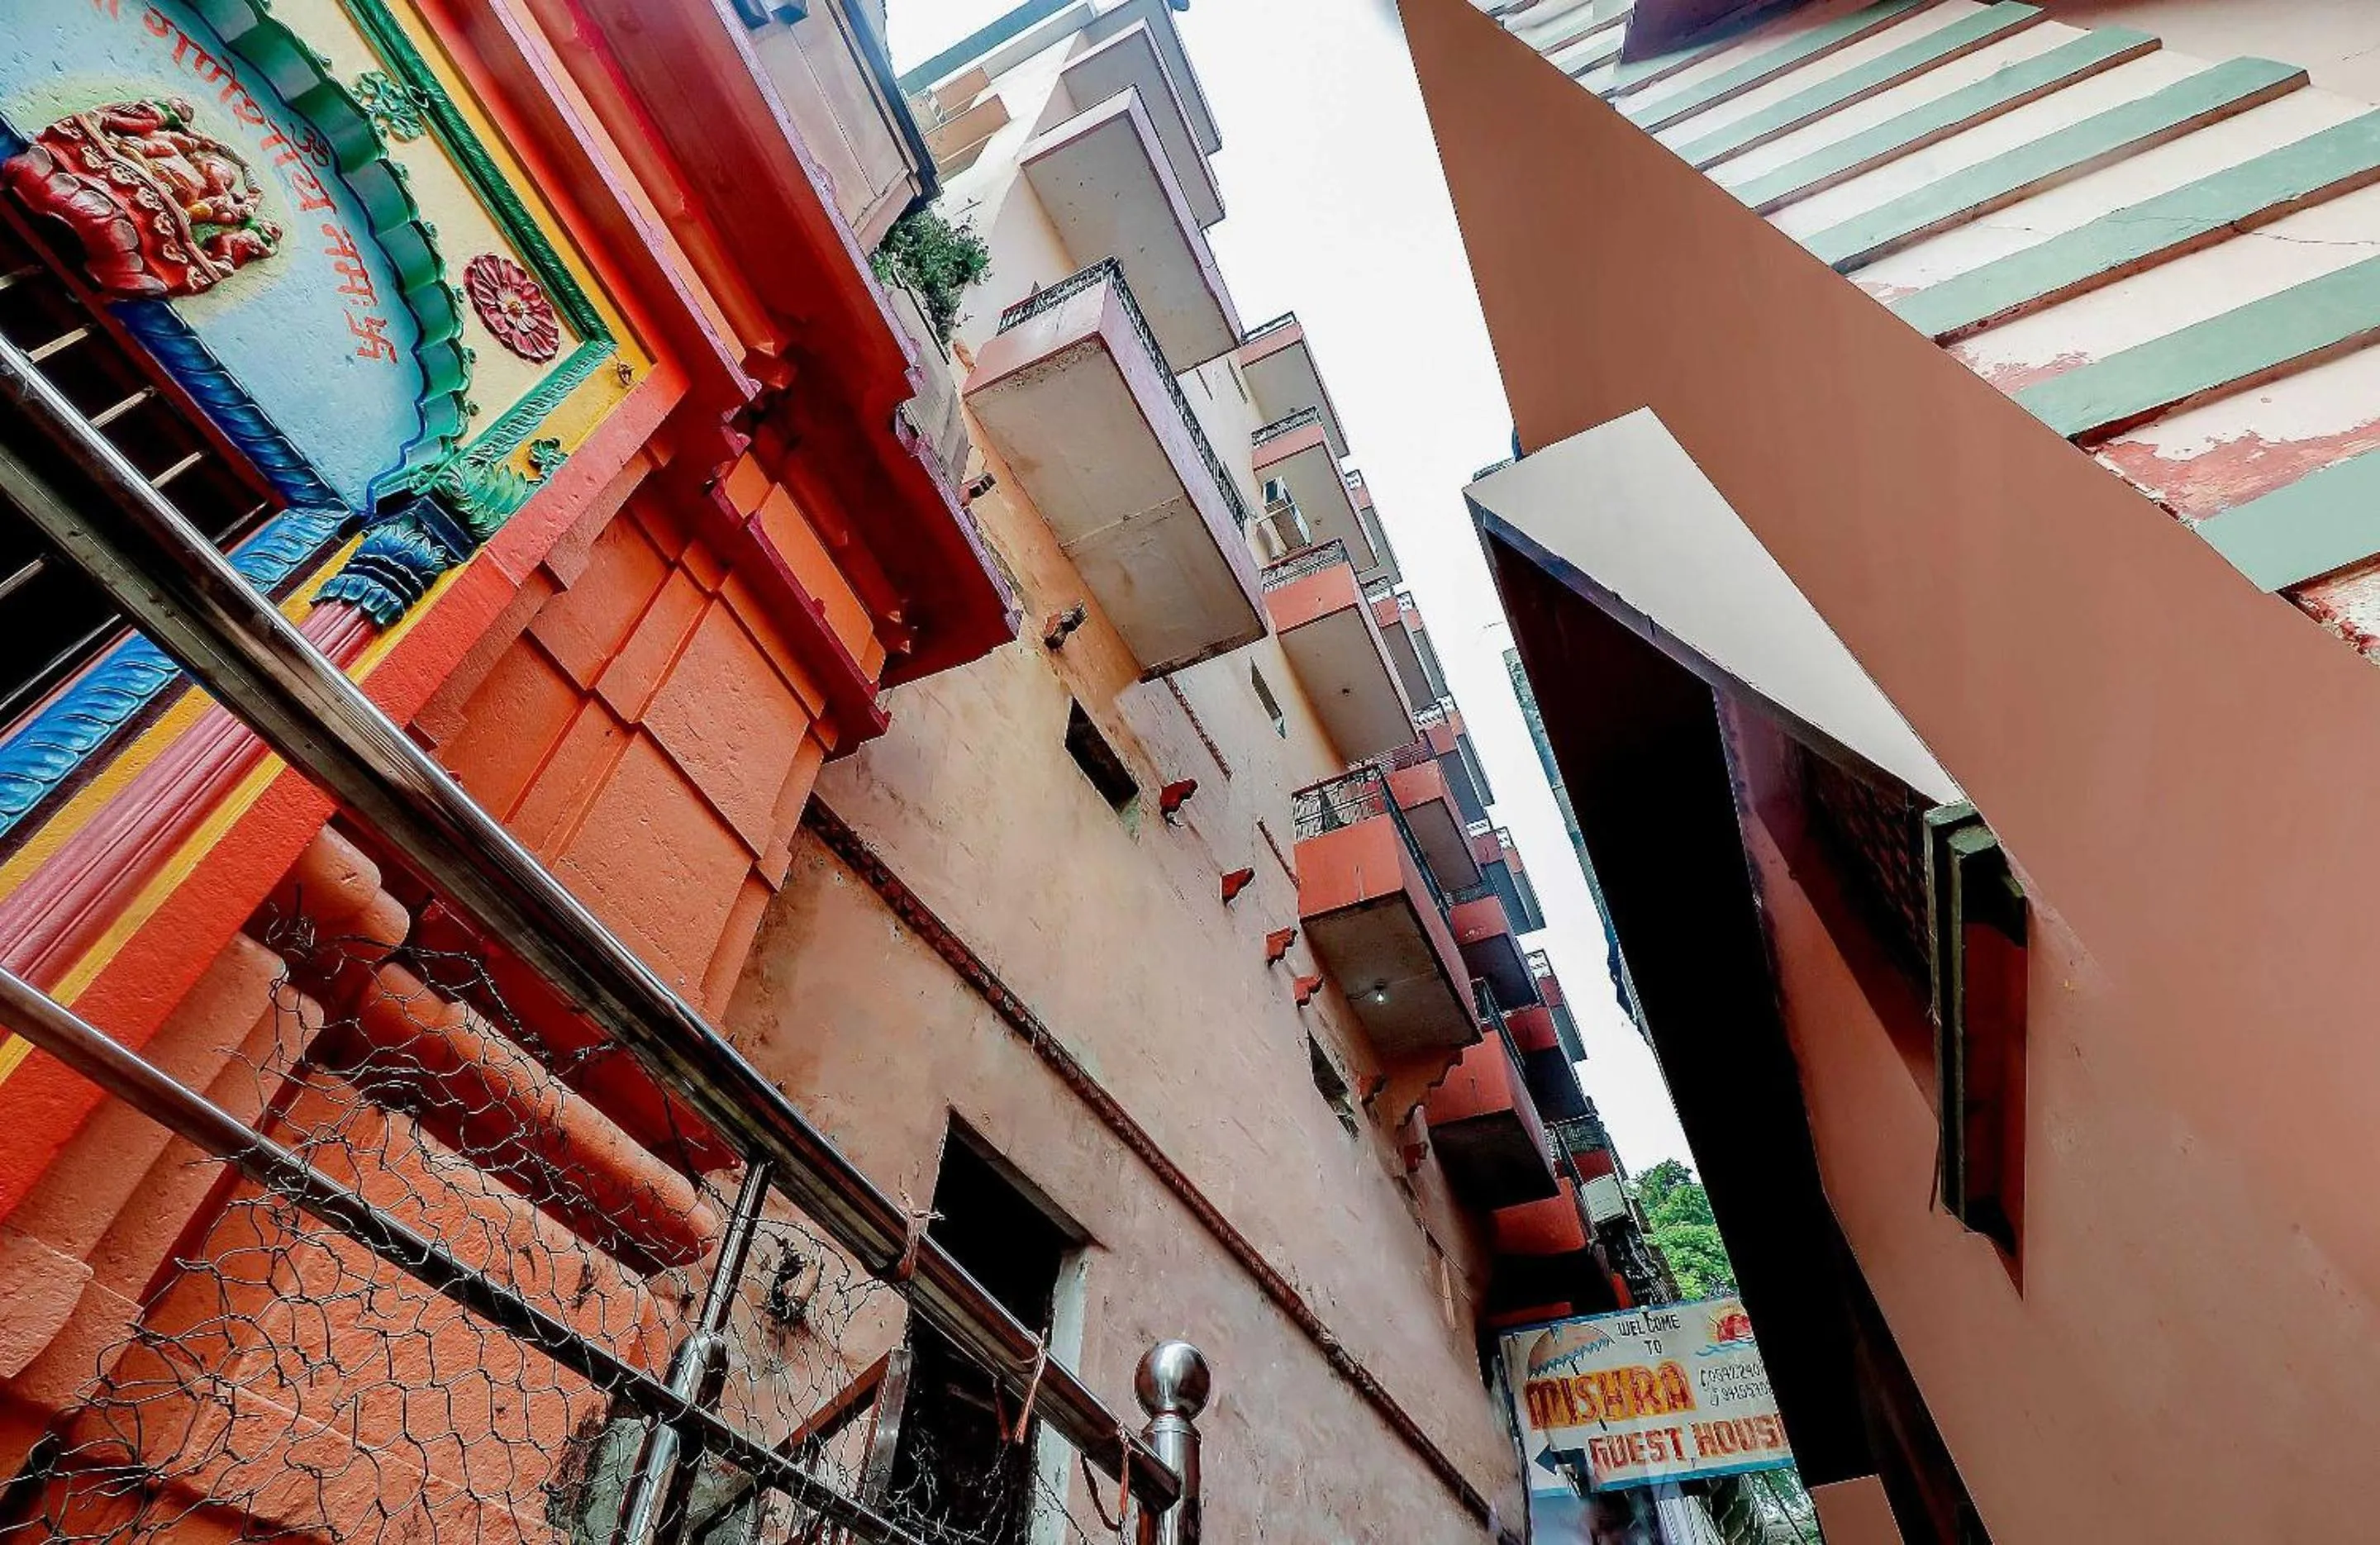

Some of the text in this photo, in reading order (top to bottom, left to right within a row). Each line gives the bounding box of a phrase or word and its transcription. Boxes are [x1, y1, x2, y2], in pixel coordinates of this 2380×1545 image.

[321, 224, 378, 308] नमः
[1616, 1314, 1681, 1337] WELCOME
[1645, 1339, 1663, 1356] TO
[1525, 1362, 1697, 1430] MISHRA
[1587, 1428, 1686, 1471] GUEST
